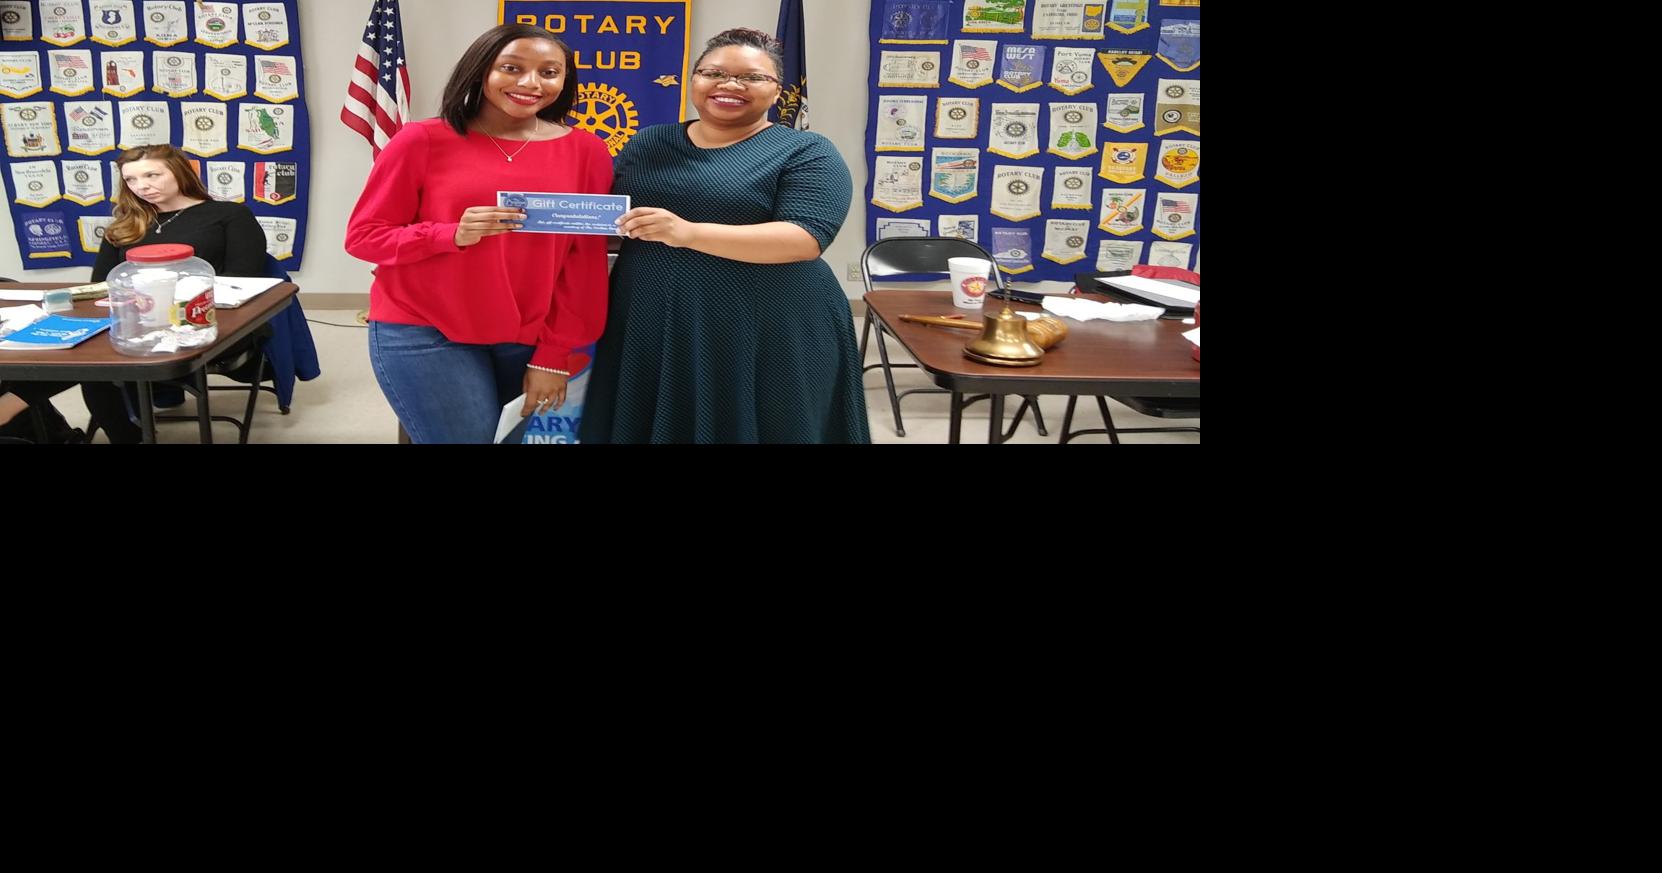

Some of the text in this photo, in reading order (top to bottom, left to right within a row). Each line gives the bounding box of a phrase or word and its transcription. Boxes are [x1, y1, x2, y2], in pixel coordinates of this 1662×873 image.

[1007, 46, 1036, 54] MESA
[574, 51, 641, 70] LUB
[578, 91, 616, 104] OTARY
[208, 107, 224, 116] CLUB
[1024, 172, 1040, 180] CLUB
[532, 199, 623, 211] Gift Certificate
[527, 416, 580, 432] ARY
